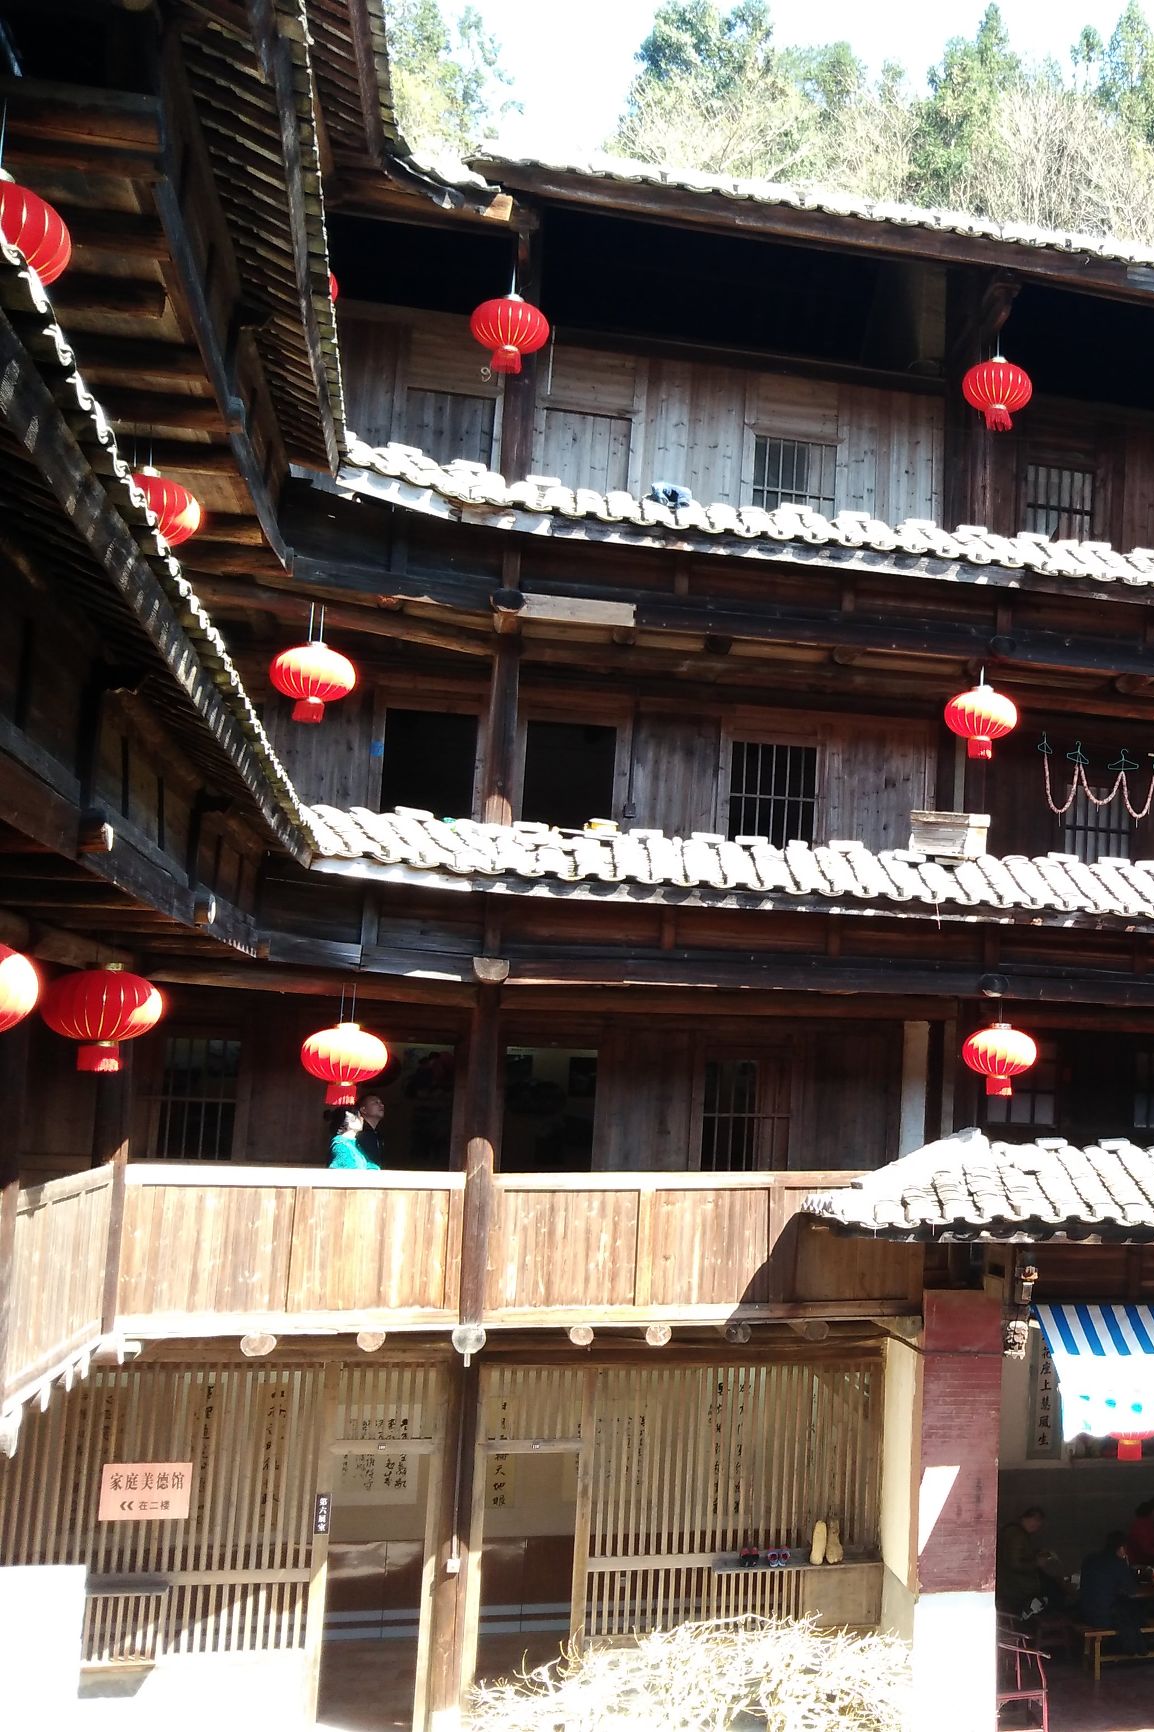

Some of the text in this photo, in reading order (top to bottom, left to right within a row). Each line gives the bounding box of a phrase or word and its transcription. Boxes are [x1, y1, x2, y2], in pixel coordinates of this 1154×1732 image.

[110, 1472, 184, 1491] 家庭美德馆
[138, 1500, 171, 1510] 在二楼
[317, 1497, 328, 1532] 第六展室
